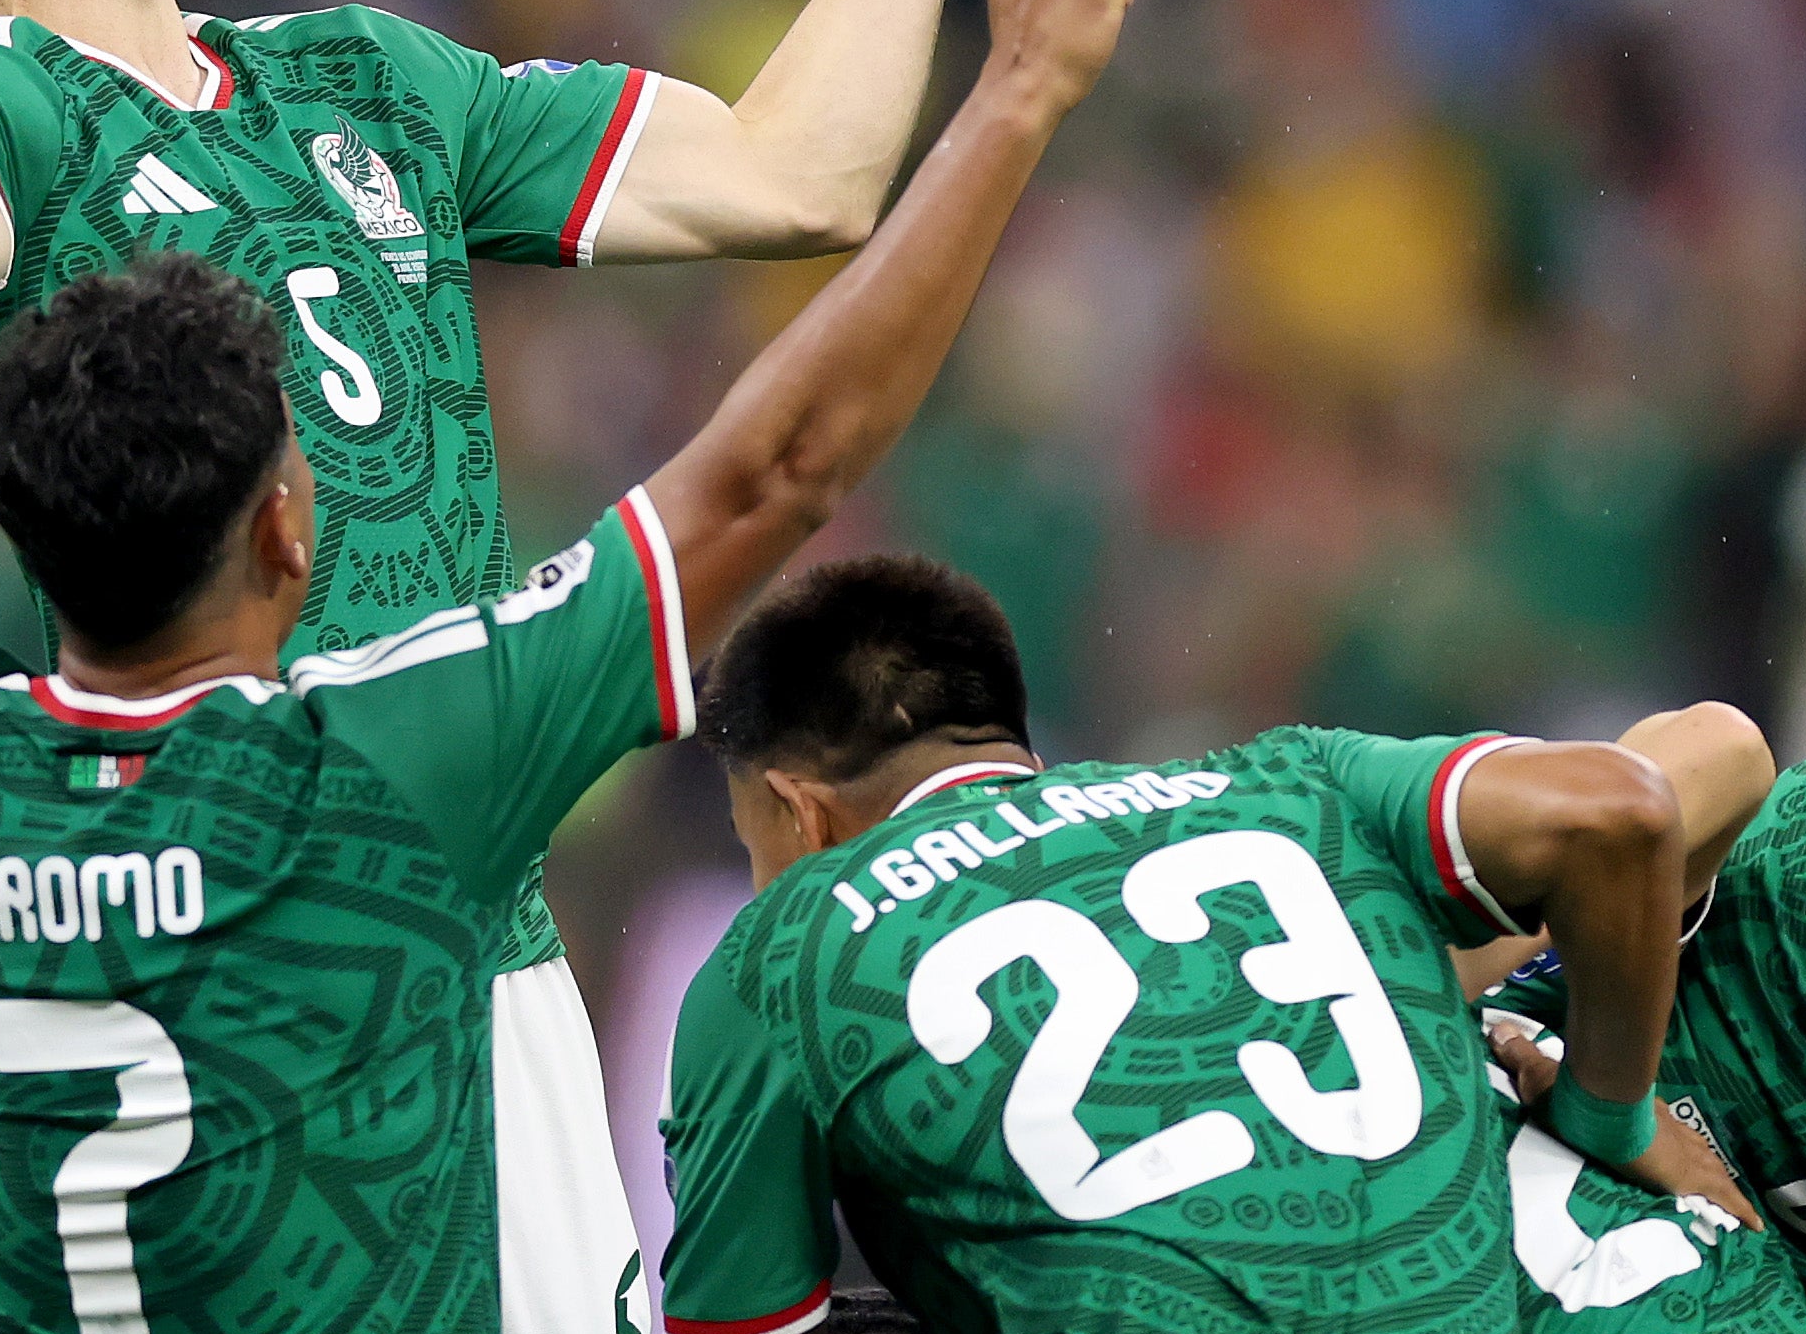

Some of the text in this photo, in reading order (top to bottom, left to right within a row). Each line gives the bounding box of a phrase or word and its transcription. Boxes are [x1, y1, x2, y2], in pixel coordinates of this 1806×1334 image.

[286, 266, 383, 426] 5
[831, 769, 1232, 934] J.GALLARDO
[905, 829, 1425, 1221] 23
